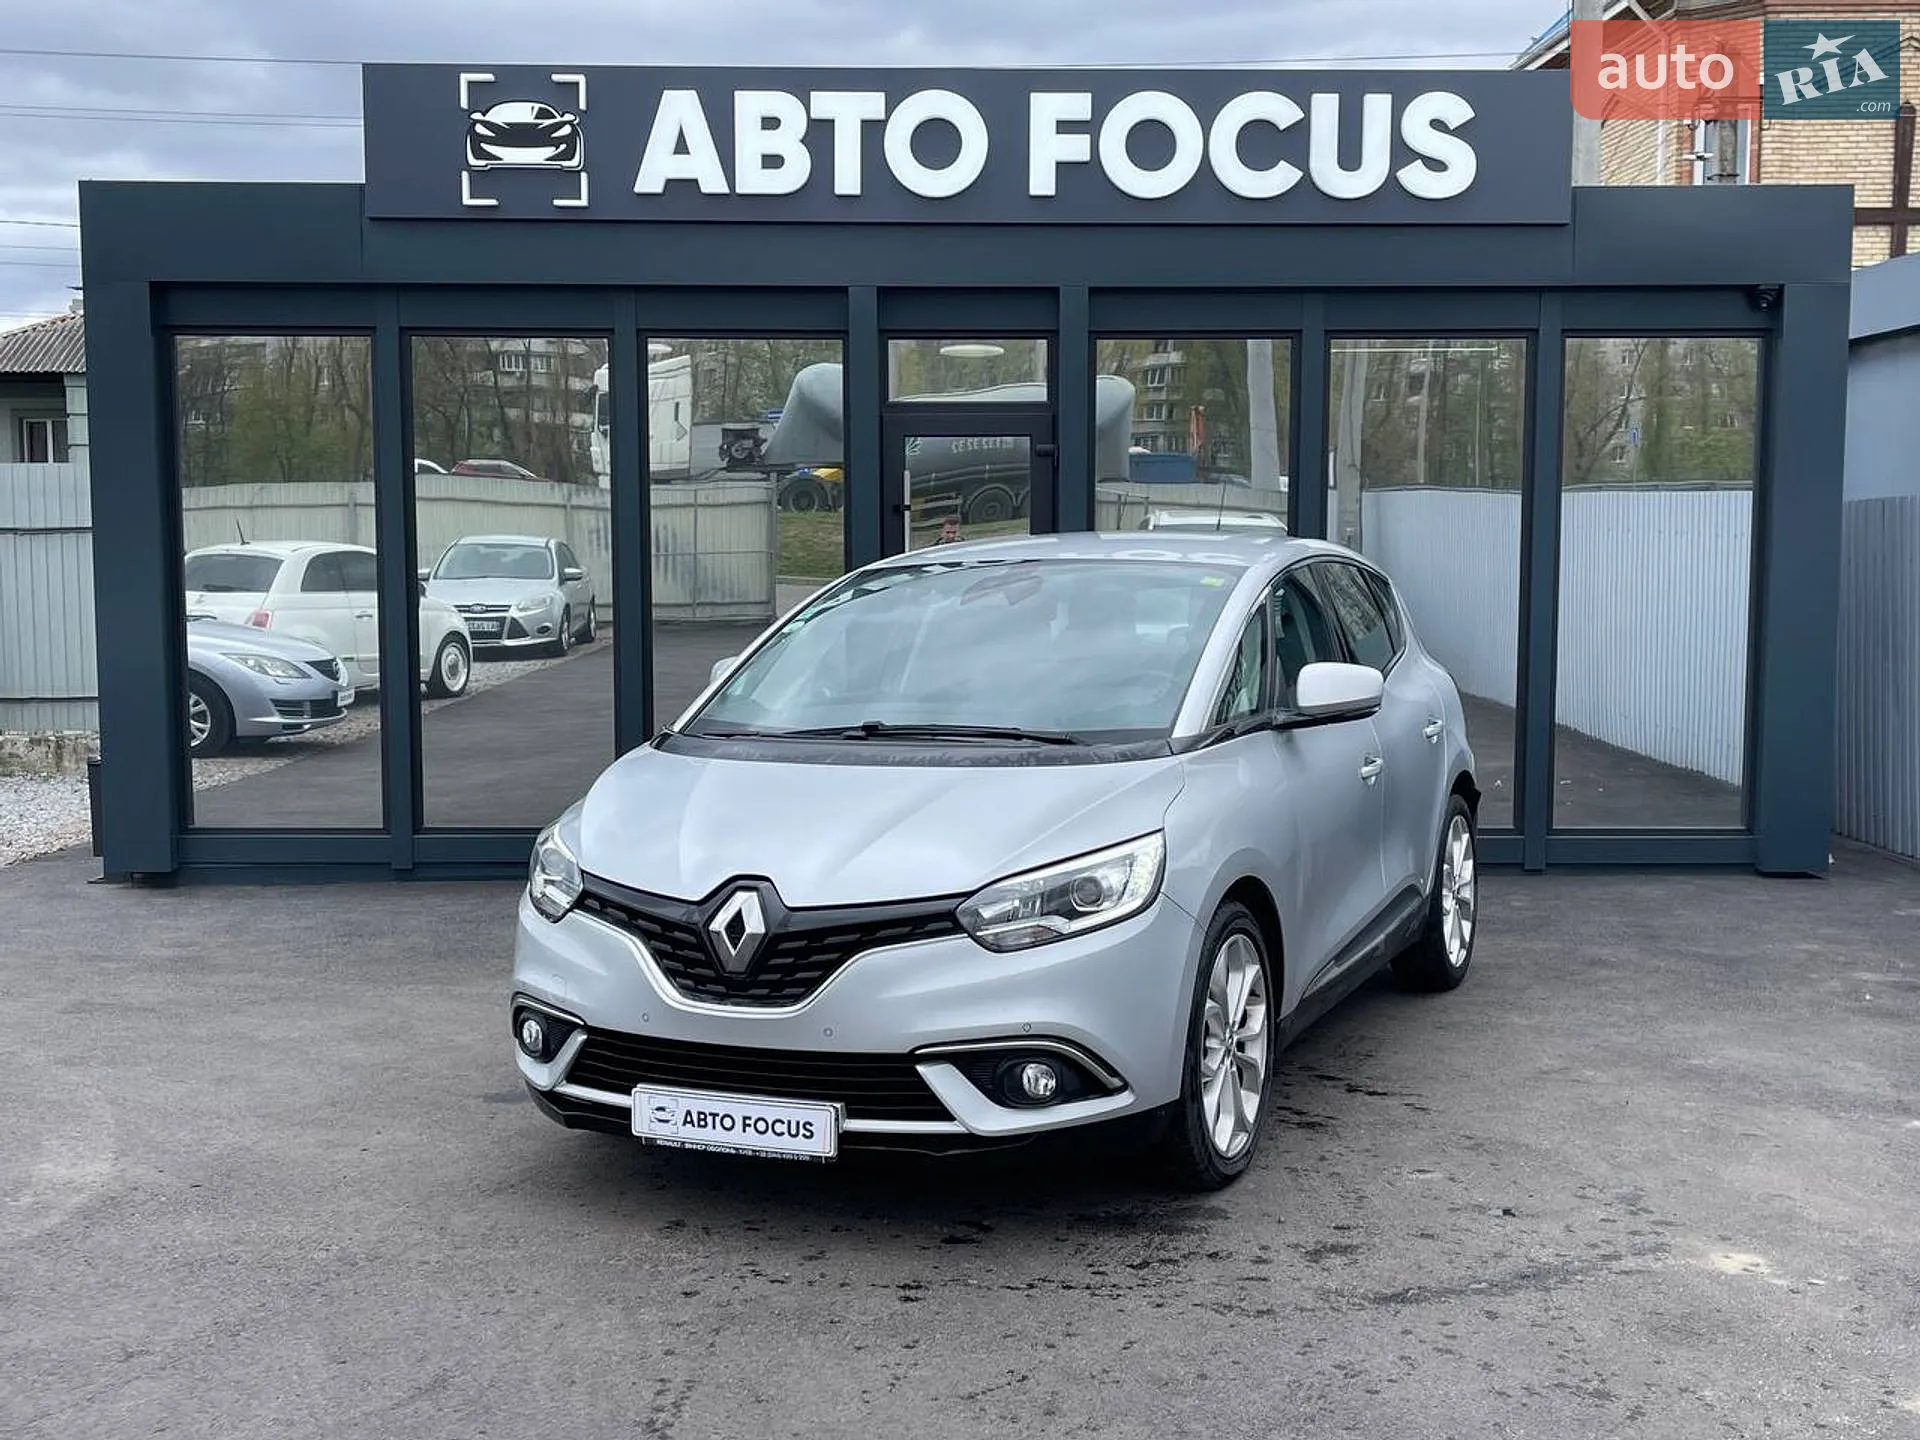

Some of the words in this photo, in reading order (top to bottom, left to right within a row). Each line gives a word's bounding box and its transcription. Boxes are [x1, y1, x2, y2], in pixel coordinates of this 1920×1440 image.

[633, 88, 989, 199] АВТО
[1028, 89, 1477, 200] FOCUS
[741, 1115, 816, 1140] FOCUS
